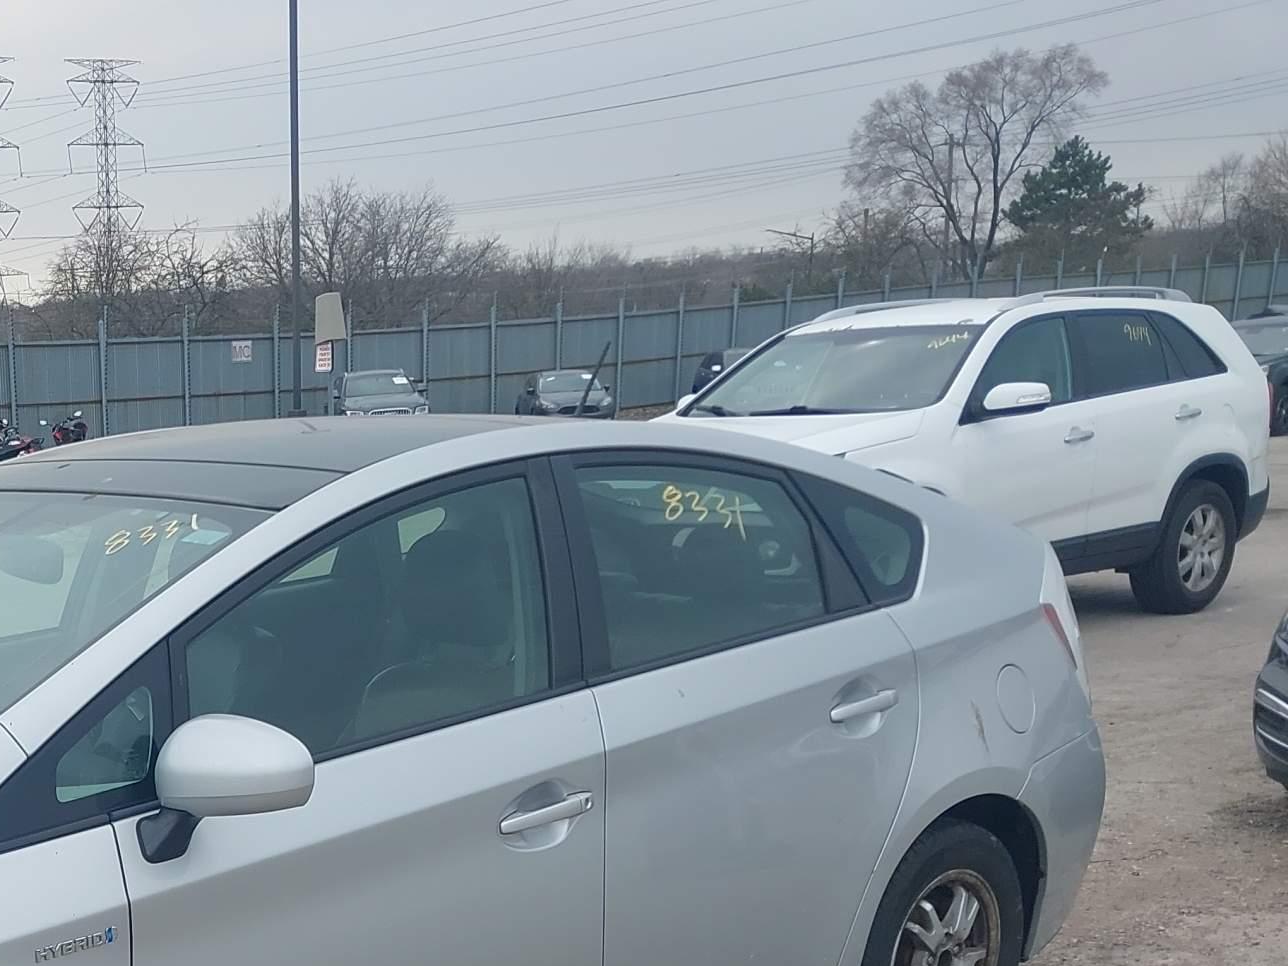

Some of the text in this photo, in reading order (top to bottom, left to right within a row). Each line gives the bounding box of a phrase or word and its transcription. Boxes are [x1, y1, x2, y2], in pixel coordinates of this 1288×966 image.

[104, 512, 199, 555] 8331
[662, 485, 747, 541] 8331
[34, 931, 103, 963] HYBRID
